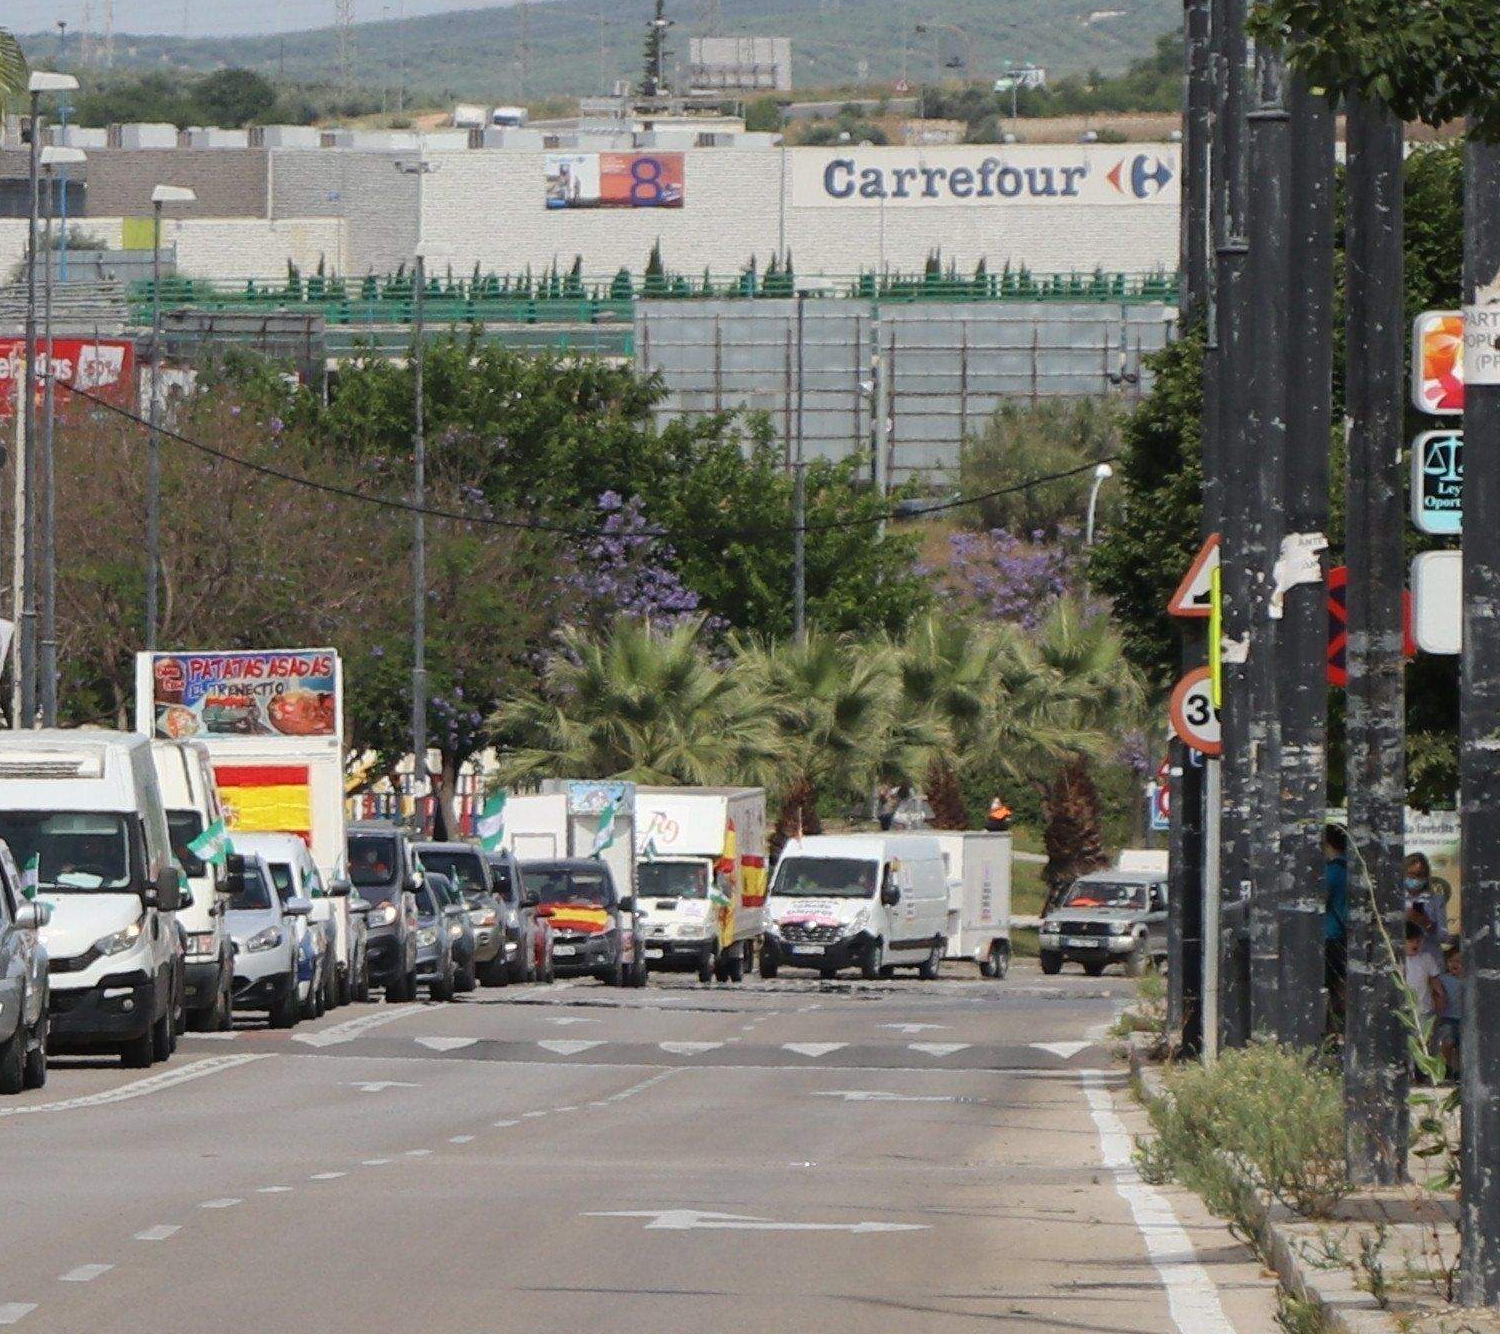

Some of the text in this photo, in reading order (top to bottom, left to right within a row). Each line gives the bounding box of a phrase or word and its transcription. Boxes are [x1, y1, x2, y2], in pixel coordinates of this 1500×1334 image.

[823, 156, 1088, 198] Carrefour
[190, 657, 265, 679] PATATAS
[267, 656, 333, 678] ASADAS
